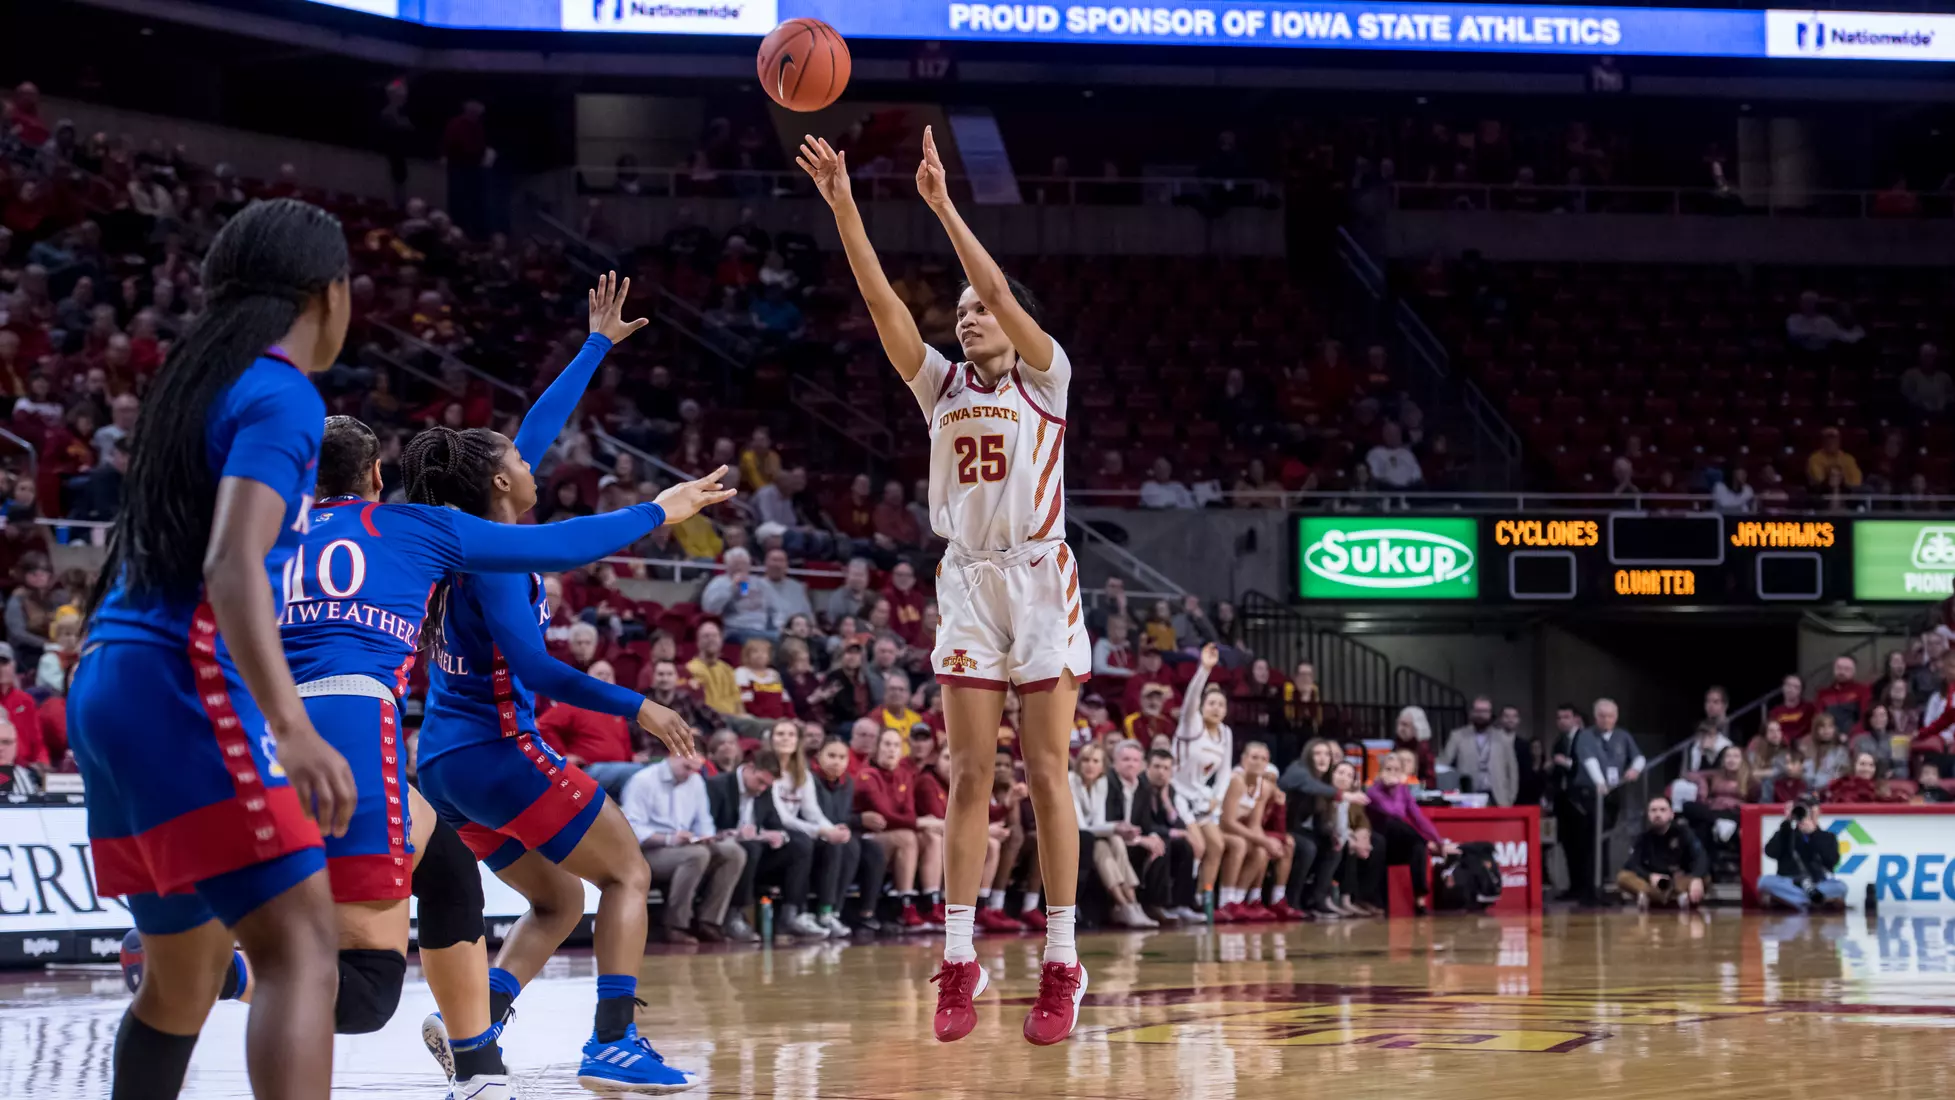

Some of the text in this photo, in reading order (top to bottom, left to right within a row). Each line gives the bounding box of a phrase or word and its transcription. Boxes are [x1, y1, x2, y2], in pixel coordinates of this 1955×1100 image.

[631, 2, 741, 19] Nationwide
[950, 4, 1622, 45] PROUD SPONSOR OF IOWA STATE ATHLETICS
[1831, 27, 1932, 47] Nationwide
[939, 405, 1020, 429] IOWA STATE
[954, 434, 1007, 485] 25
[1495, 520, 1599, 546] CYCLONES
[1731, 522, 1835, 547] JAYHAWKS
[1321, 529, 1457, 583] Sukup
[1614, 570, 1696, 595] QUARTER
[277, 601, 416, 648] IWEATHER
[942, 656, 978, 670] STATE
